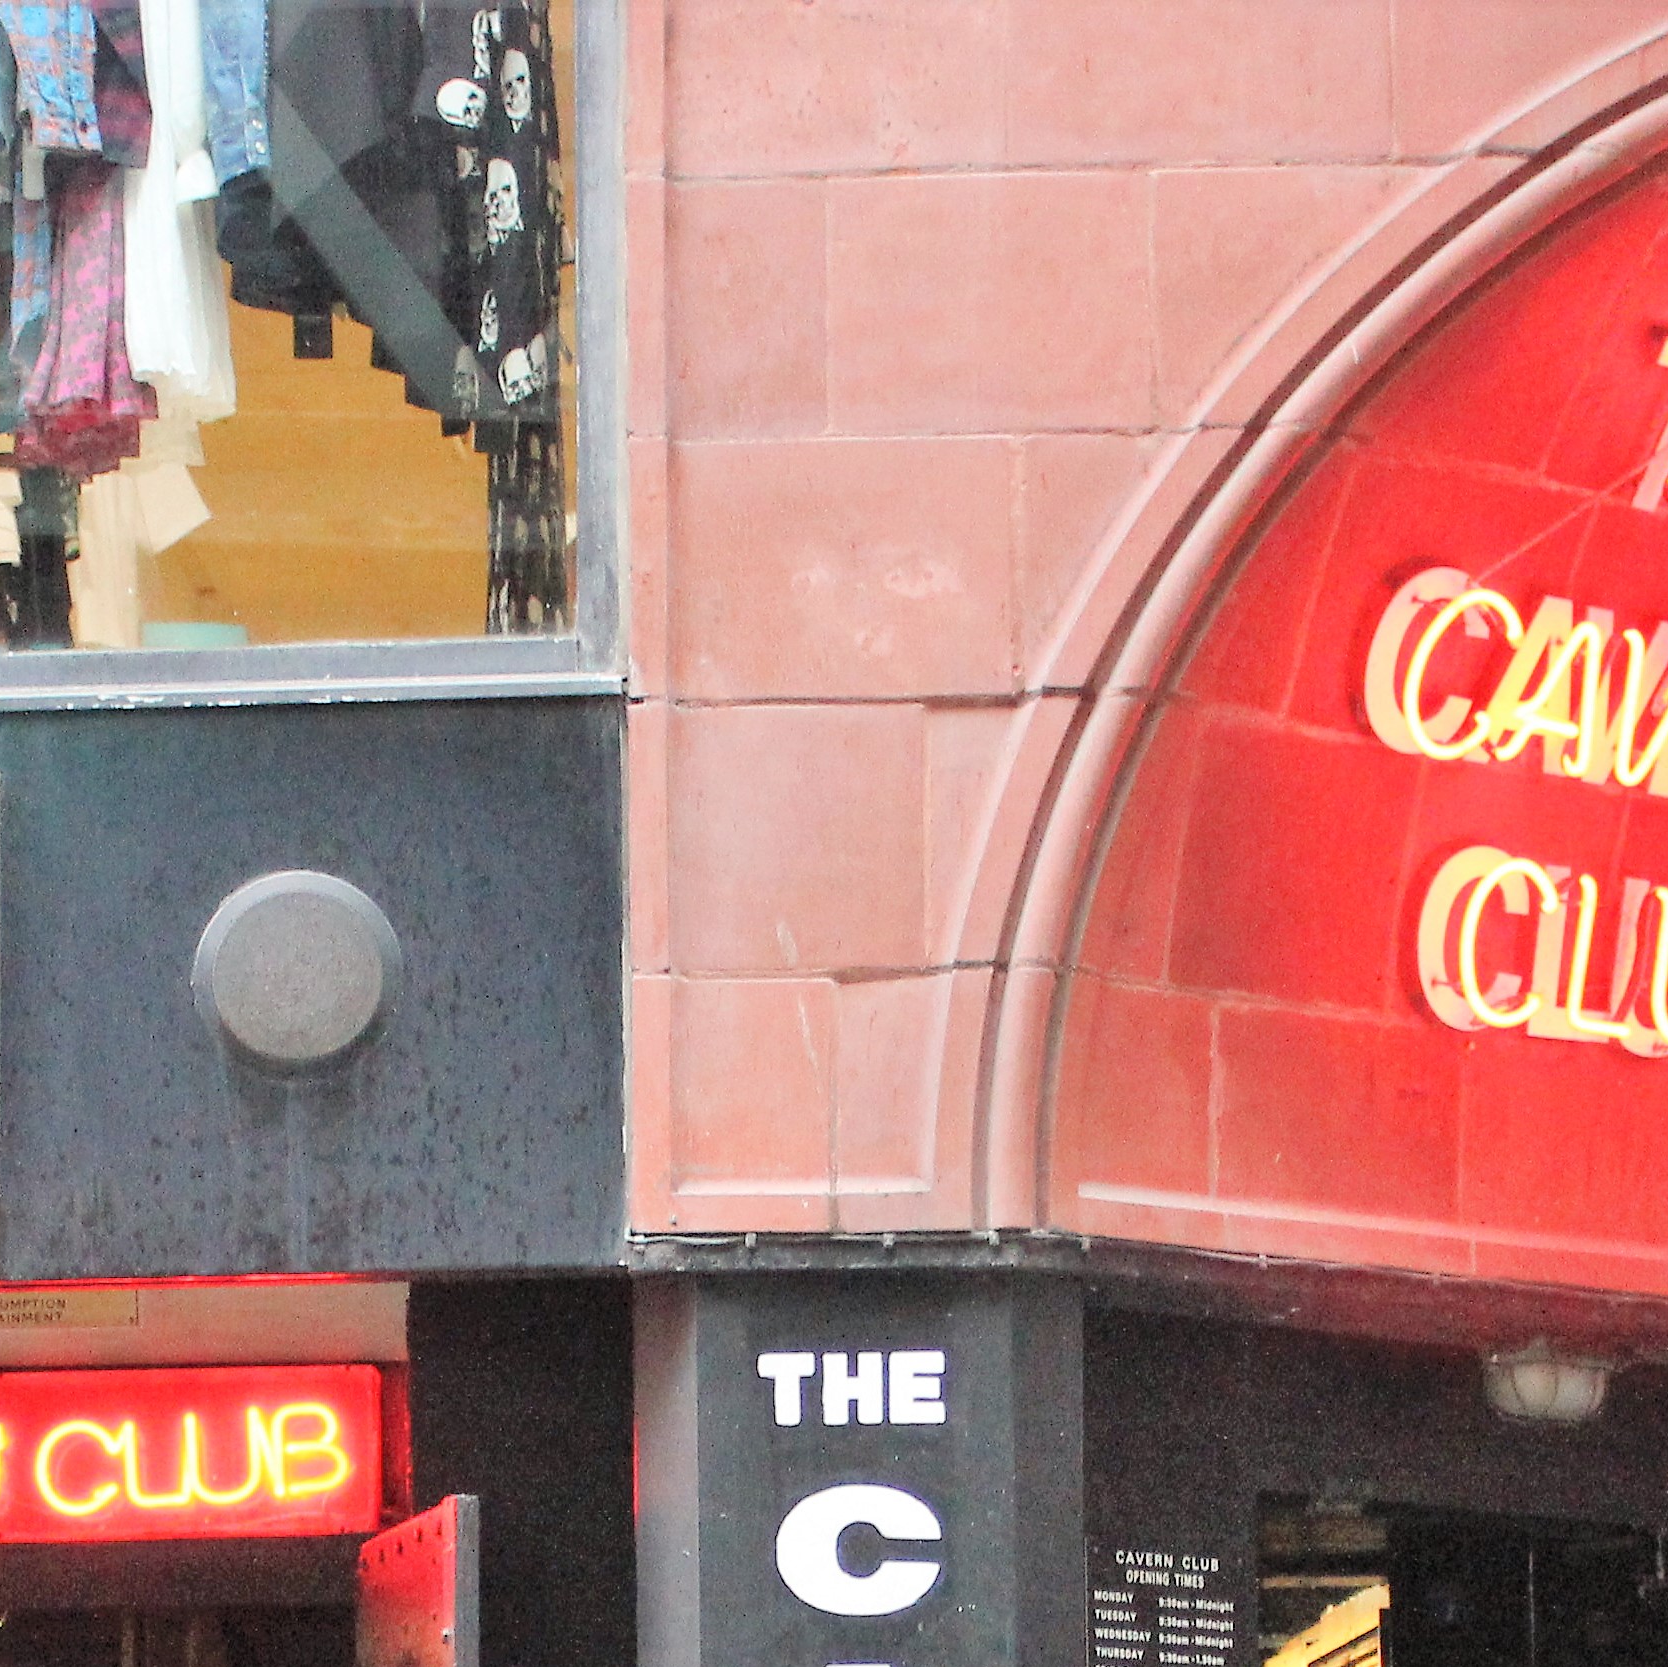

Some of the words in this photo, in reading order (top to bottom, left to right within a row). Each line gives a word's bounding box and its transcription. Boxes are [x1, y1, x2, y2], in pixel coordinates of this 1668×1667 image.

[757, 1351, 946, 1427] THE
[36, 1402, 354, 1516] CLUB
[1116, 1550, 1173, 1568] CAVERN
[1182, 1556, 1219, 1572] CLUB
[1126, 1570, 1169, 1587] OPENING
[1174, 1573, 1205, 1589] TIMES
[1094, 1590, 1133, 1603] MONDAY
[1094, 1609, 1137, 1622] TUESDAY
[1094, 1628, 1151, 1642] WEDNESDAY
[1094, 1646, 1144, 1660] THURSDAY
